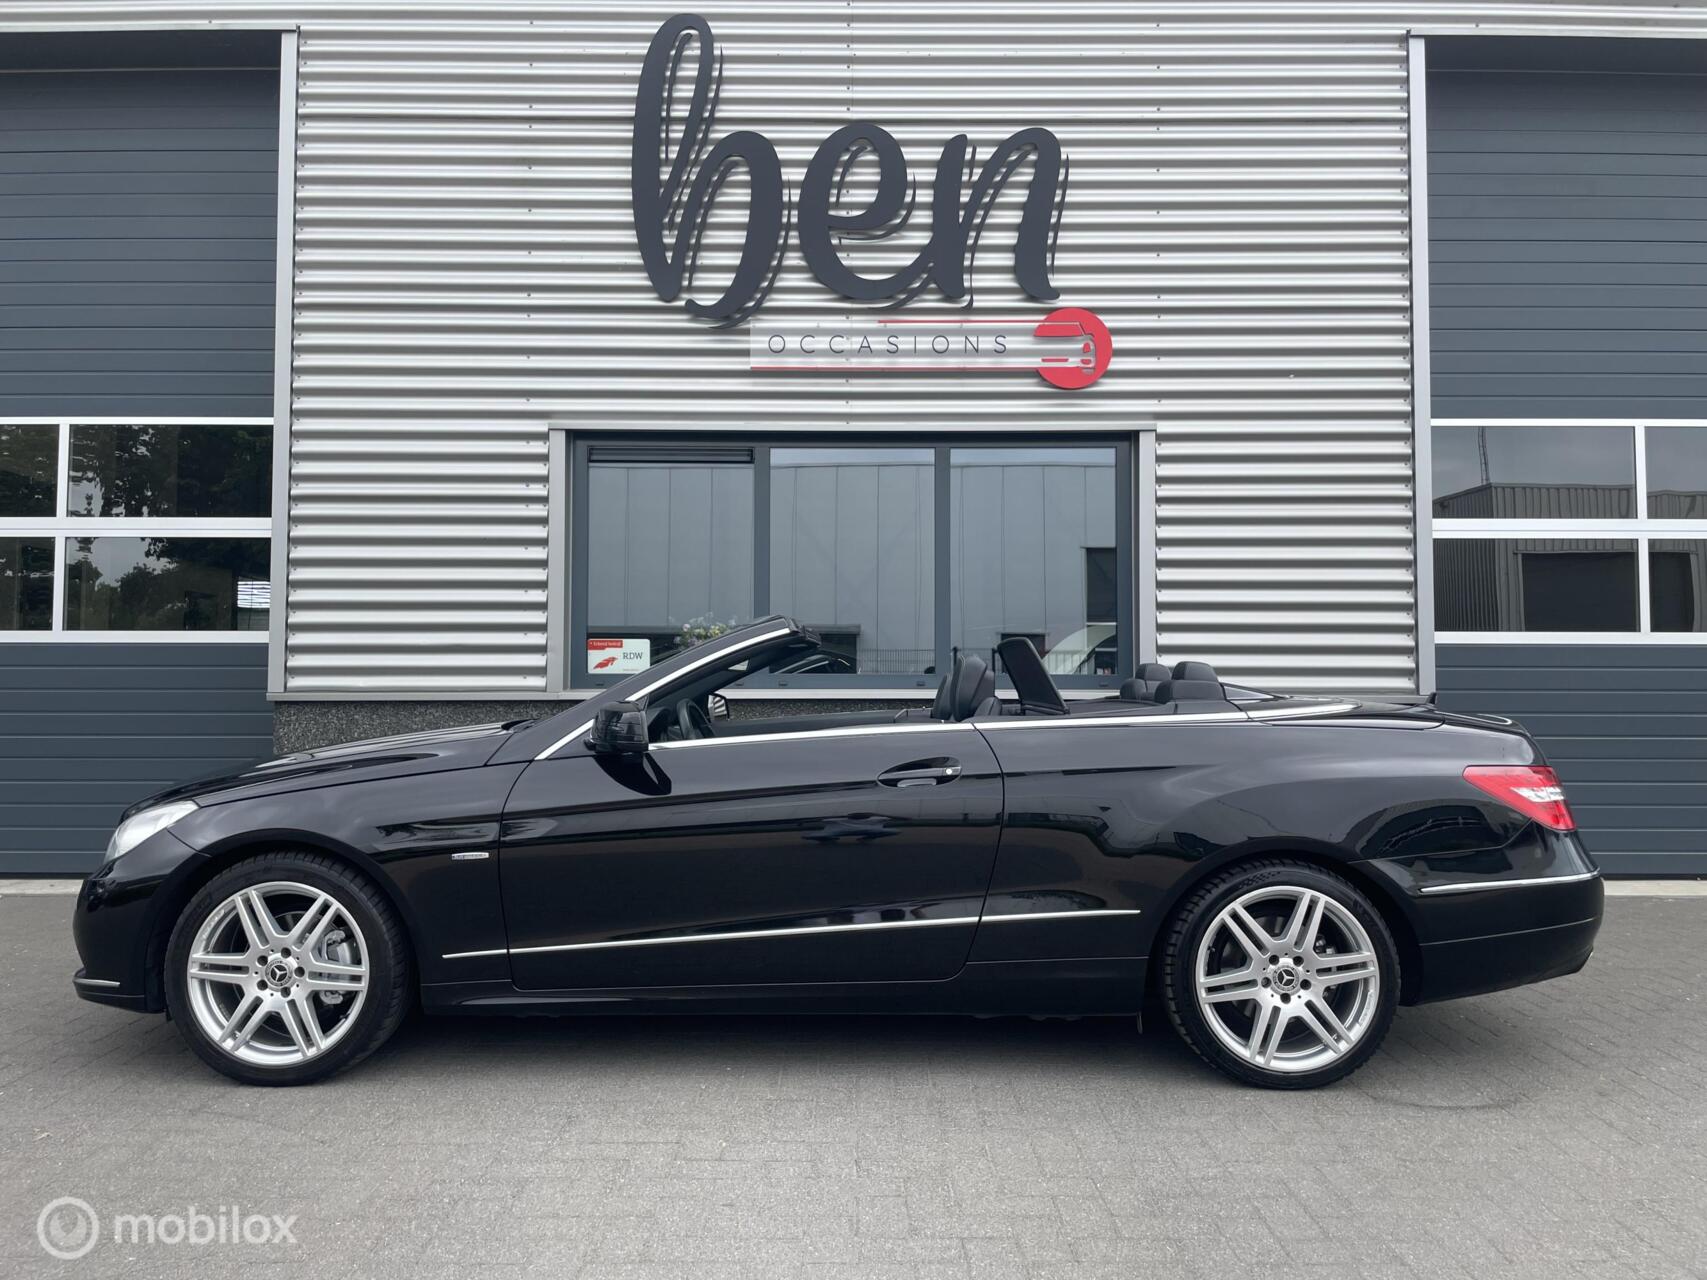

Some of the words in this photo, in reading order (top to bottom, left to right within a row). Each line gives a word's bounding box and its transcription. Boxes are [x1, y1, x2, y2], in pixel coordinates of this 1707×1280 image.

[632, 13, 1068, 327] ben
[767, 334, 1009, 355] OCCASIONS
[622, 652, 643, 660] RDW
